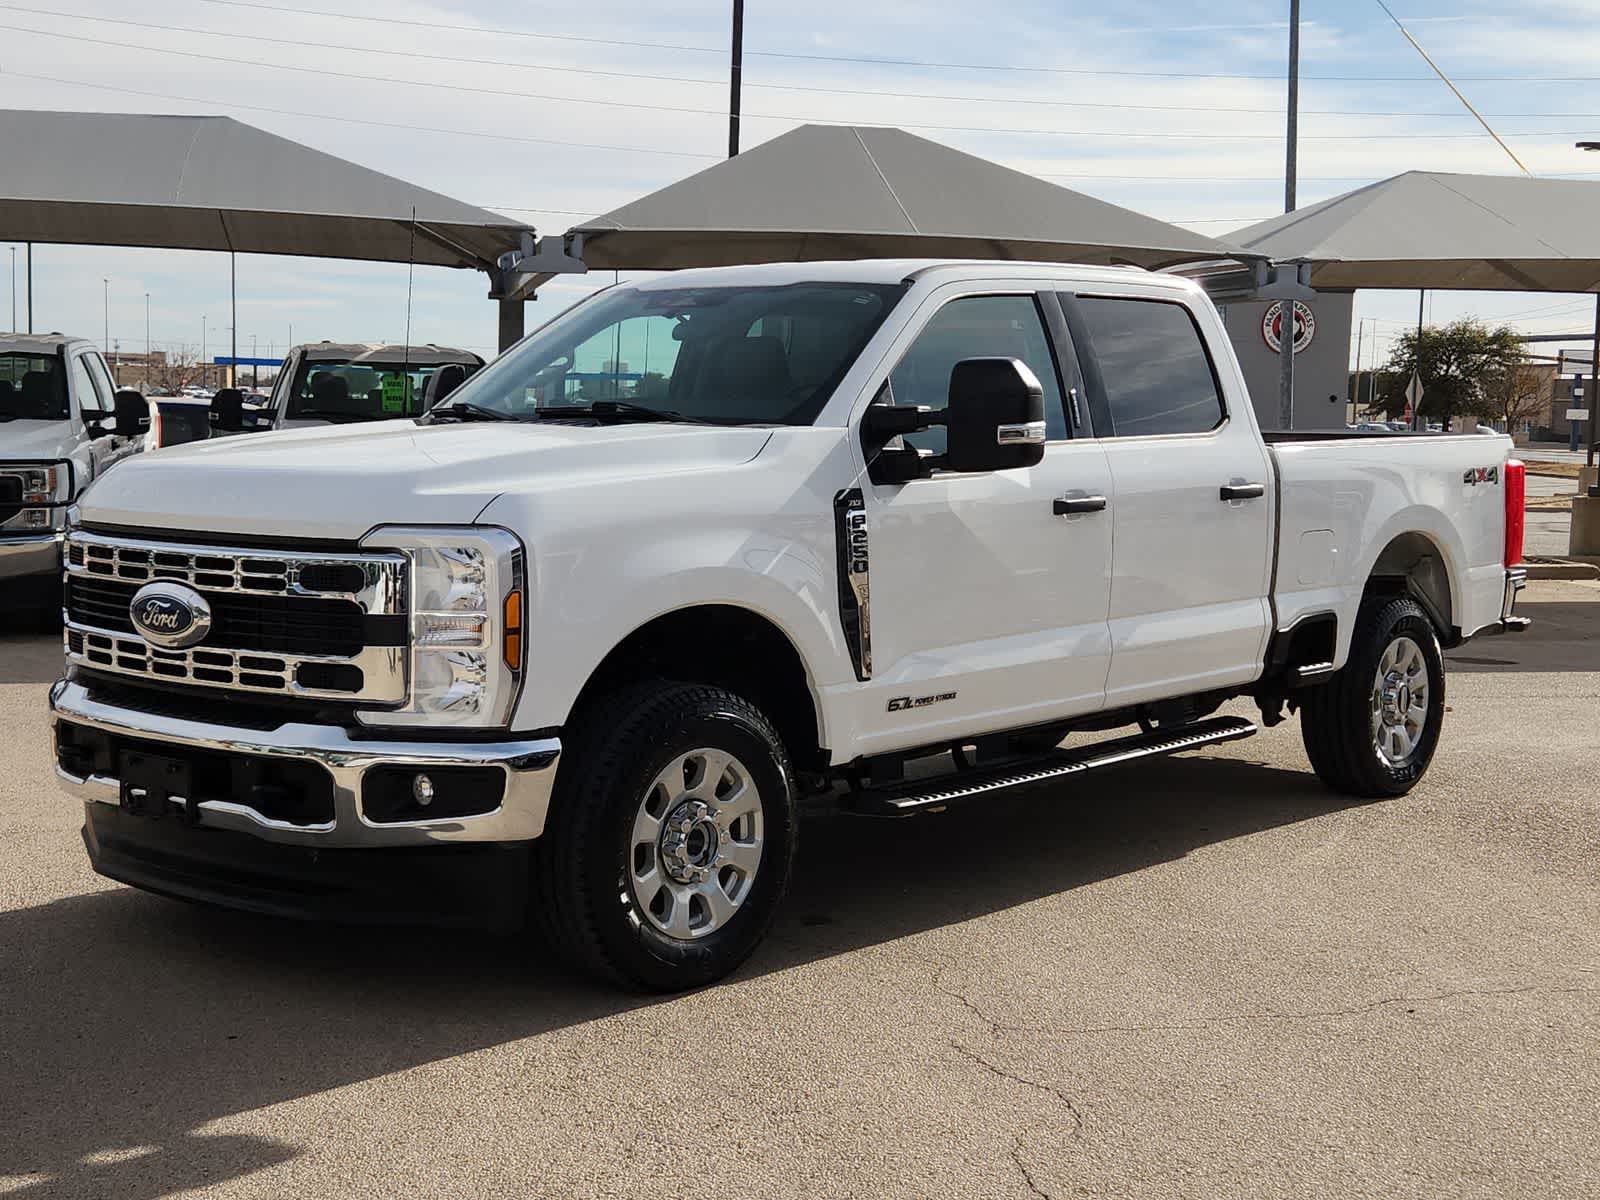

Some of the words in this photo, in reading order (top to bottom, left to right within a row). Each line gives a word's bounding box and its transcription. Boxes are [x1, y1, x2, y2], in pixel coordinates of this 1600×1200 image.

[1265, 304, 1282, 327] PAND
[142, 600, 180, 629] Ford
[888, 697, 914, 712] 6.7L
